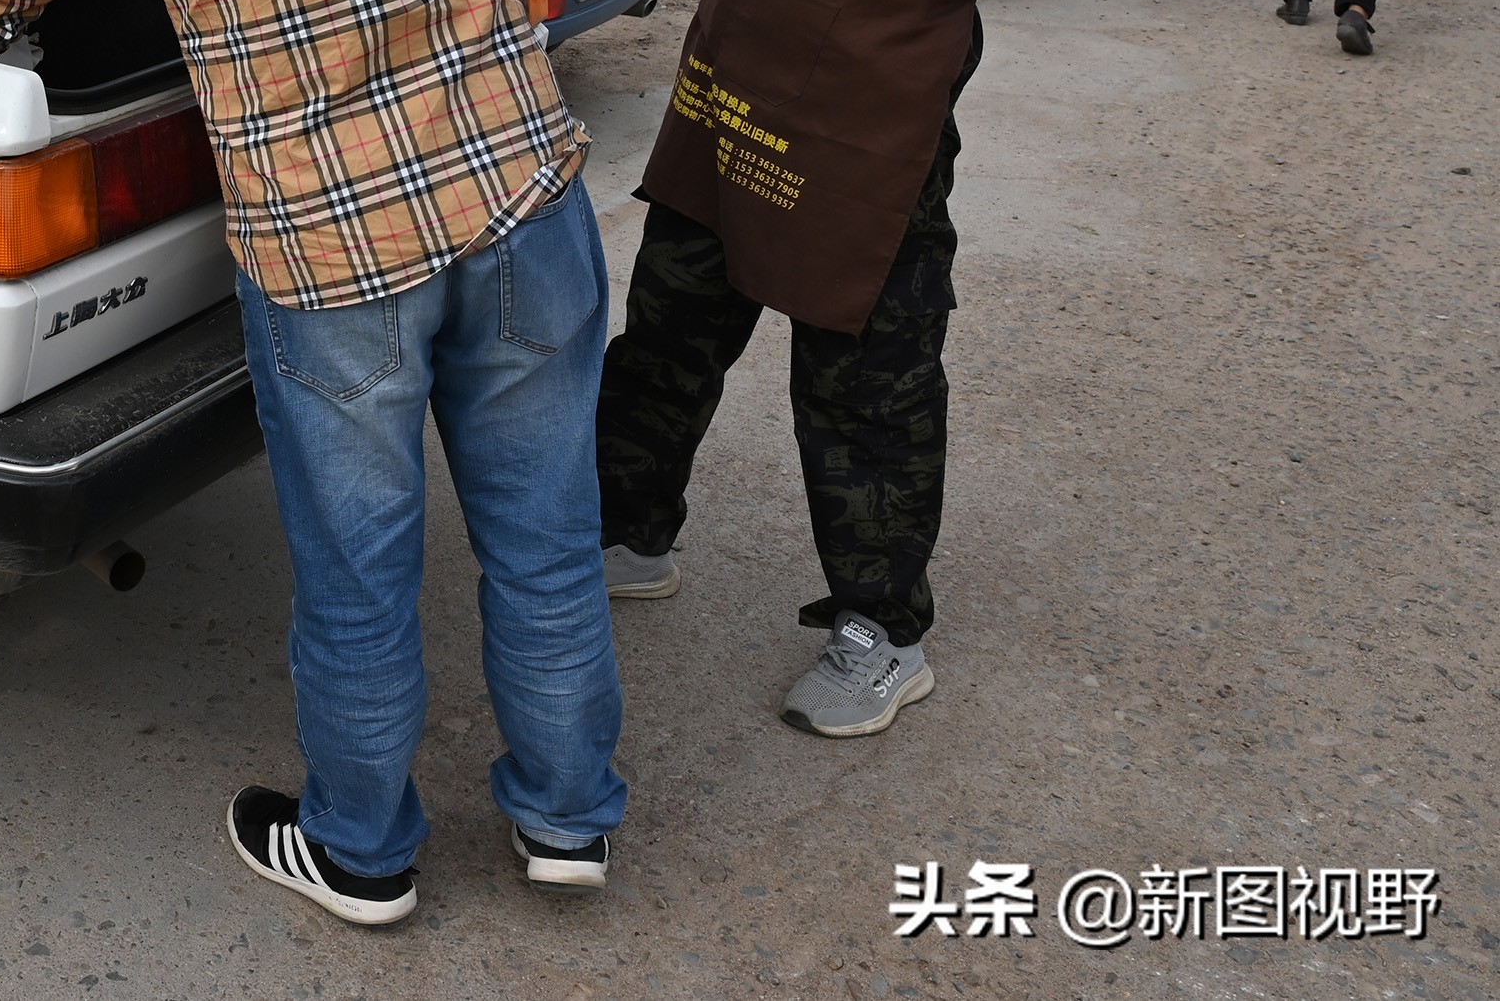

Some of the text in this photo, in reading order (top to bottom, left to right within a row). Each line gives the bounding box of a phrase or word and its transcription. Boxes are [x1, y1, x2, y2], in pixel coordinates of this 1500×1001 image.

[753, 169, 776, 187] 3633
[777, 181, 801, 199] 7905
[757, 157, 781, 176] 3633
[781, 169, 805, 186] 2637
[748, 181, 771, 199] 3633
[771, 193, 796, 211] 9357
[844, 628, 871, 646] FASHION
[847, 620, 875, 638] SPORT
